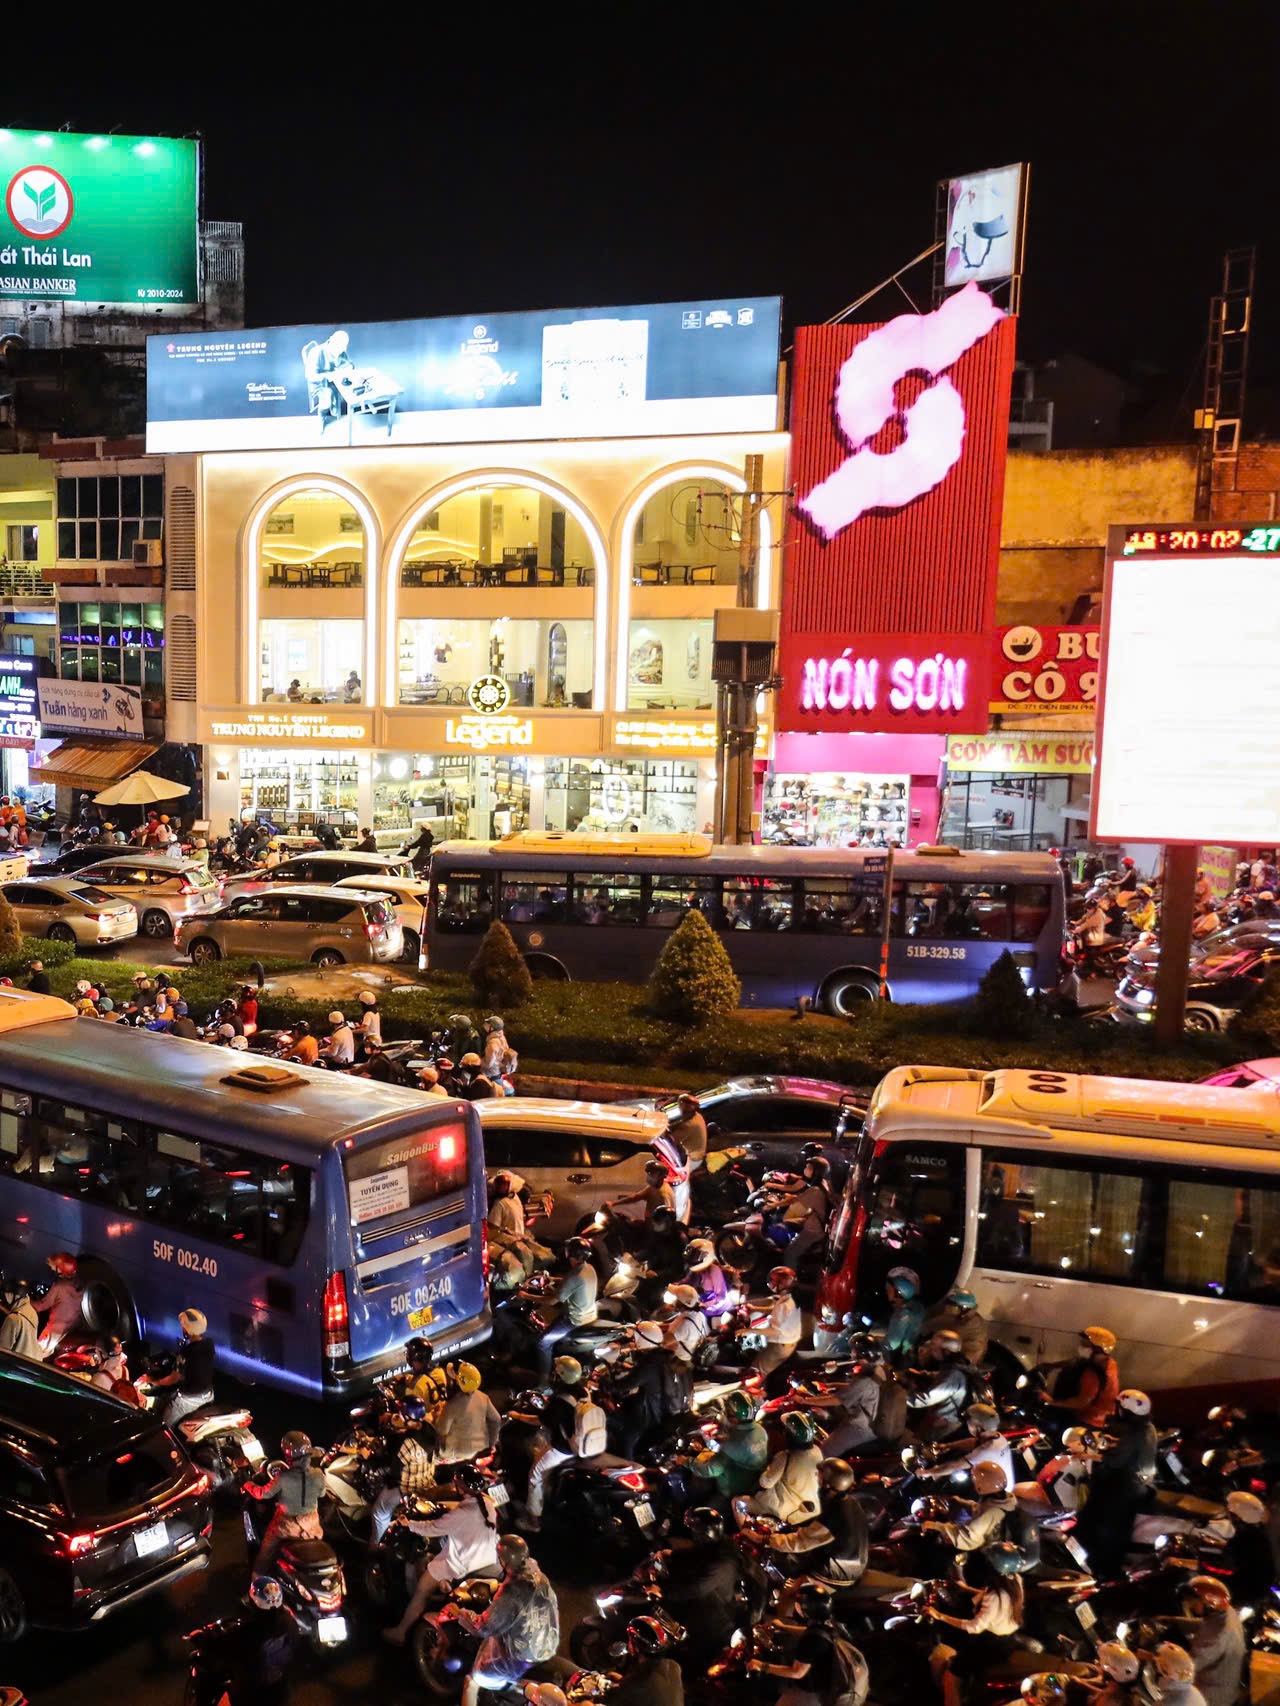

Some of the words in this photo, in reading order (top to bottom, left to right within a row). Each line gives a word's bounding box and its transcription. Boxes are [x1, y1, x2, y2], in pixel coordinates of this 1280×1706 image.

[22, 247, 57, 266] Thái
[63, 249, 91, 267] Lan
[32, 278, 77, 291] BANKER
[148, 289, 183, 298] 2010-2024
[176, 345, 202, 353] TRUNG
[237, 342, 267, 350] LEGEND
[801, 648, 877, 711] NÓN
[889, 654, 968, 711] SƠN
[1002, 660, 1066, 701] CÔ
[88, 707, 108, 720] xanh
[445, 719, 533, 748] Legend
[906, 946, 966, 960] 51B-329.58
[386, 1141, 440, 1165] SaigonBus
[904, 1154, 947, 1167] SAMCO
[153, 1240, 174, 1262] 50F
[177, 1248, 218, 1277] 002.40
[414, 1276, 452, 1307] 002.40
